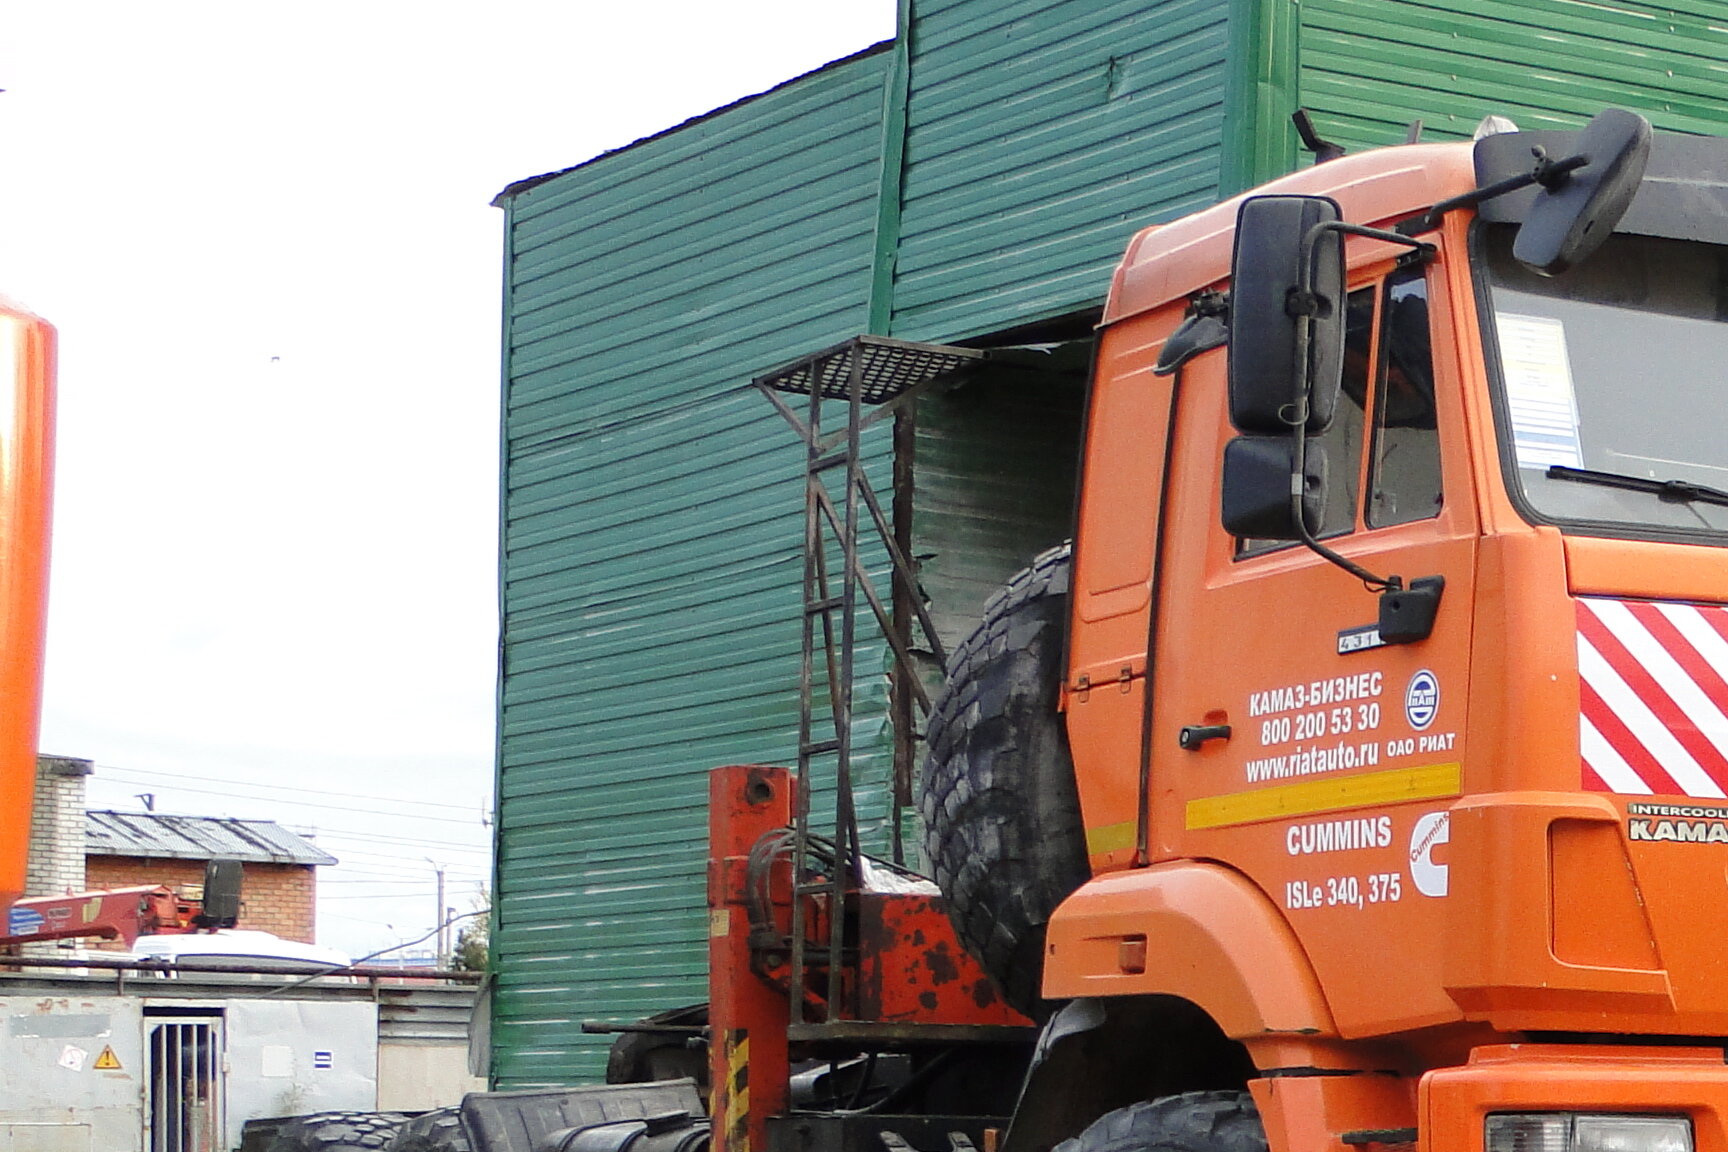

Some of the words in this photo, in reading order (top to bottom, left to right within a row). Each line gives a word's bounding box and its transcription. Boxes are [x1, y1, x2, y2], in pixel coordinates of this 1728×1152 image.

[1249, 671, 1383, 717] КАМАЗ-БИЗНЕС
[1261, 717, 1291, 746] 800
[1295, 711, 1326, 740] 200
[1330, 707, 1352, 735] 53
[1357, 702, 1380, 731] 30
[1246, 740, 1379, 783] www.riatauto.ru
[1387, 738, 1414, 757] ОАО
[1419, 733, 1455, 753] РИАТ
[1287, 816, 1391, 856] CUMMINS
[1287, 881, 1323, 909] ISLe
[1327, 876, 1364, 910] 340,
[1368, 873, 1401, 903] 375
